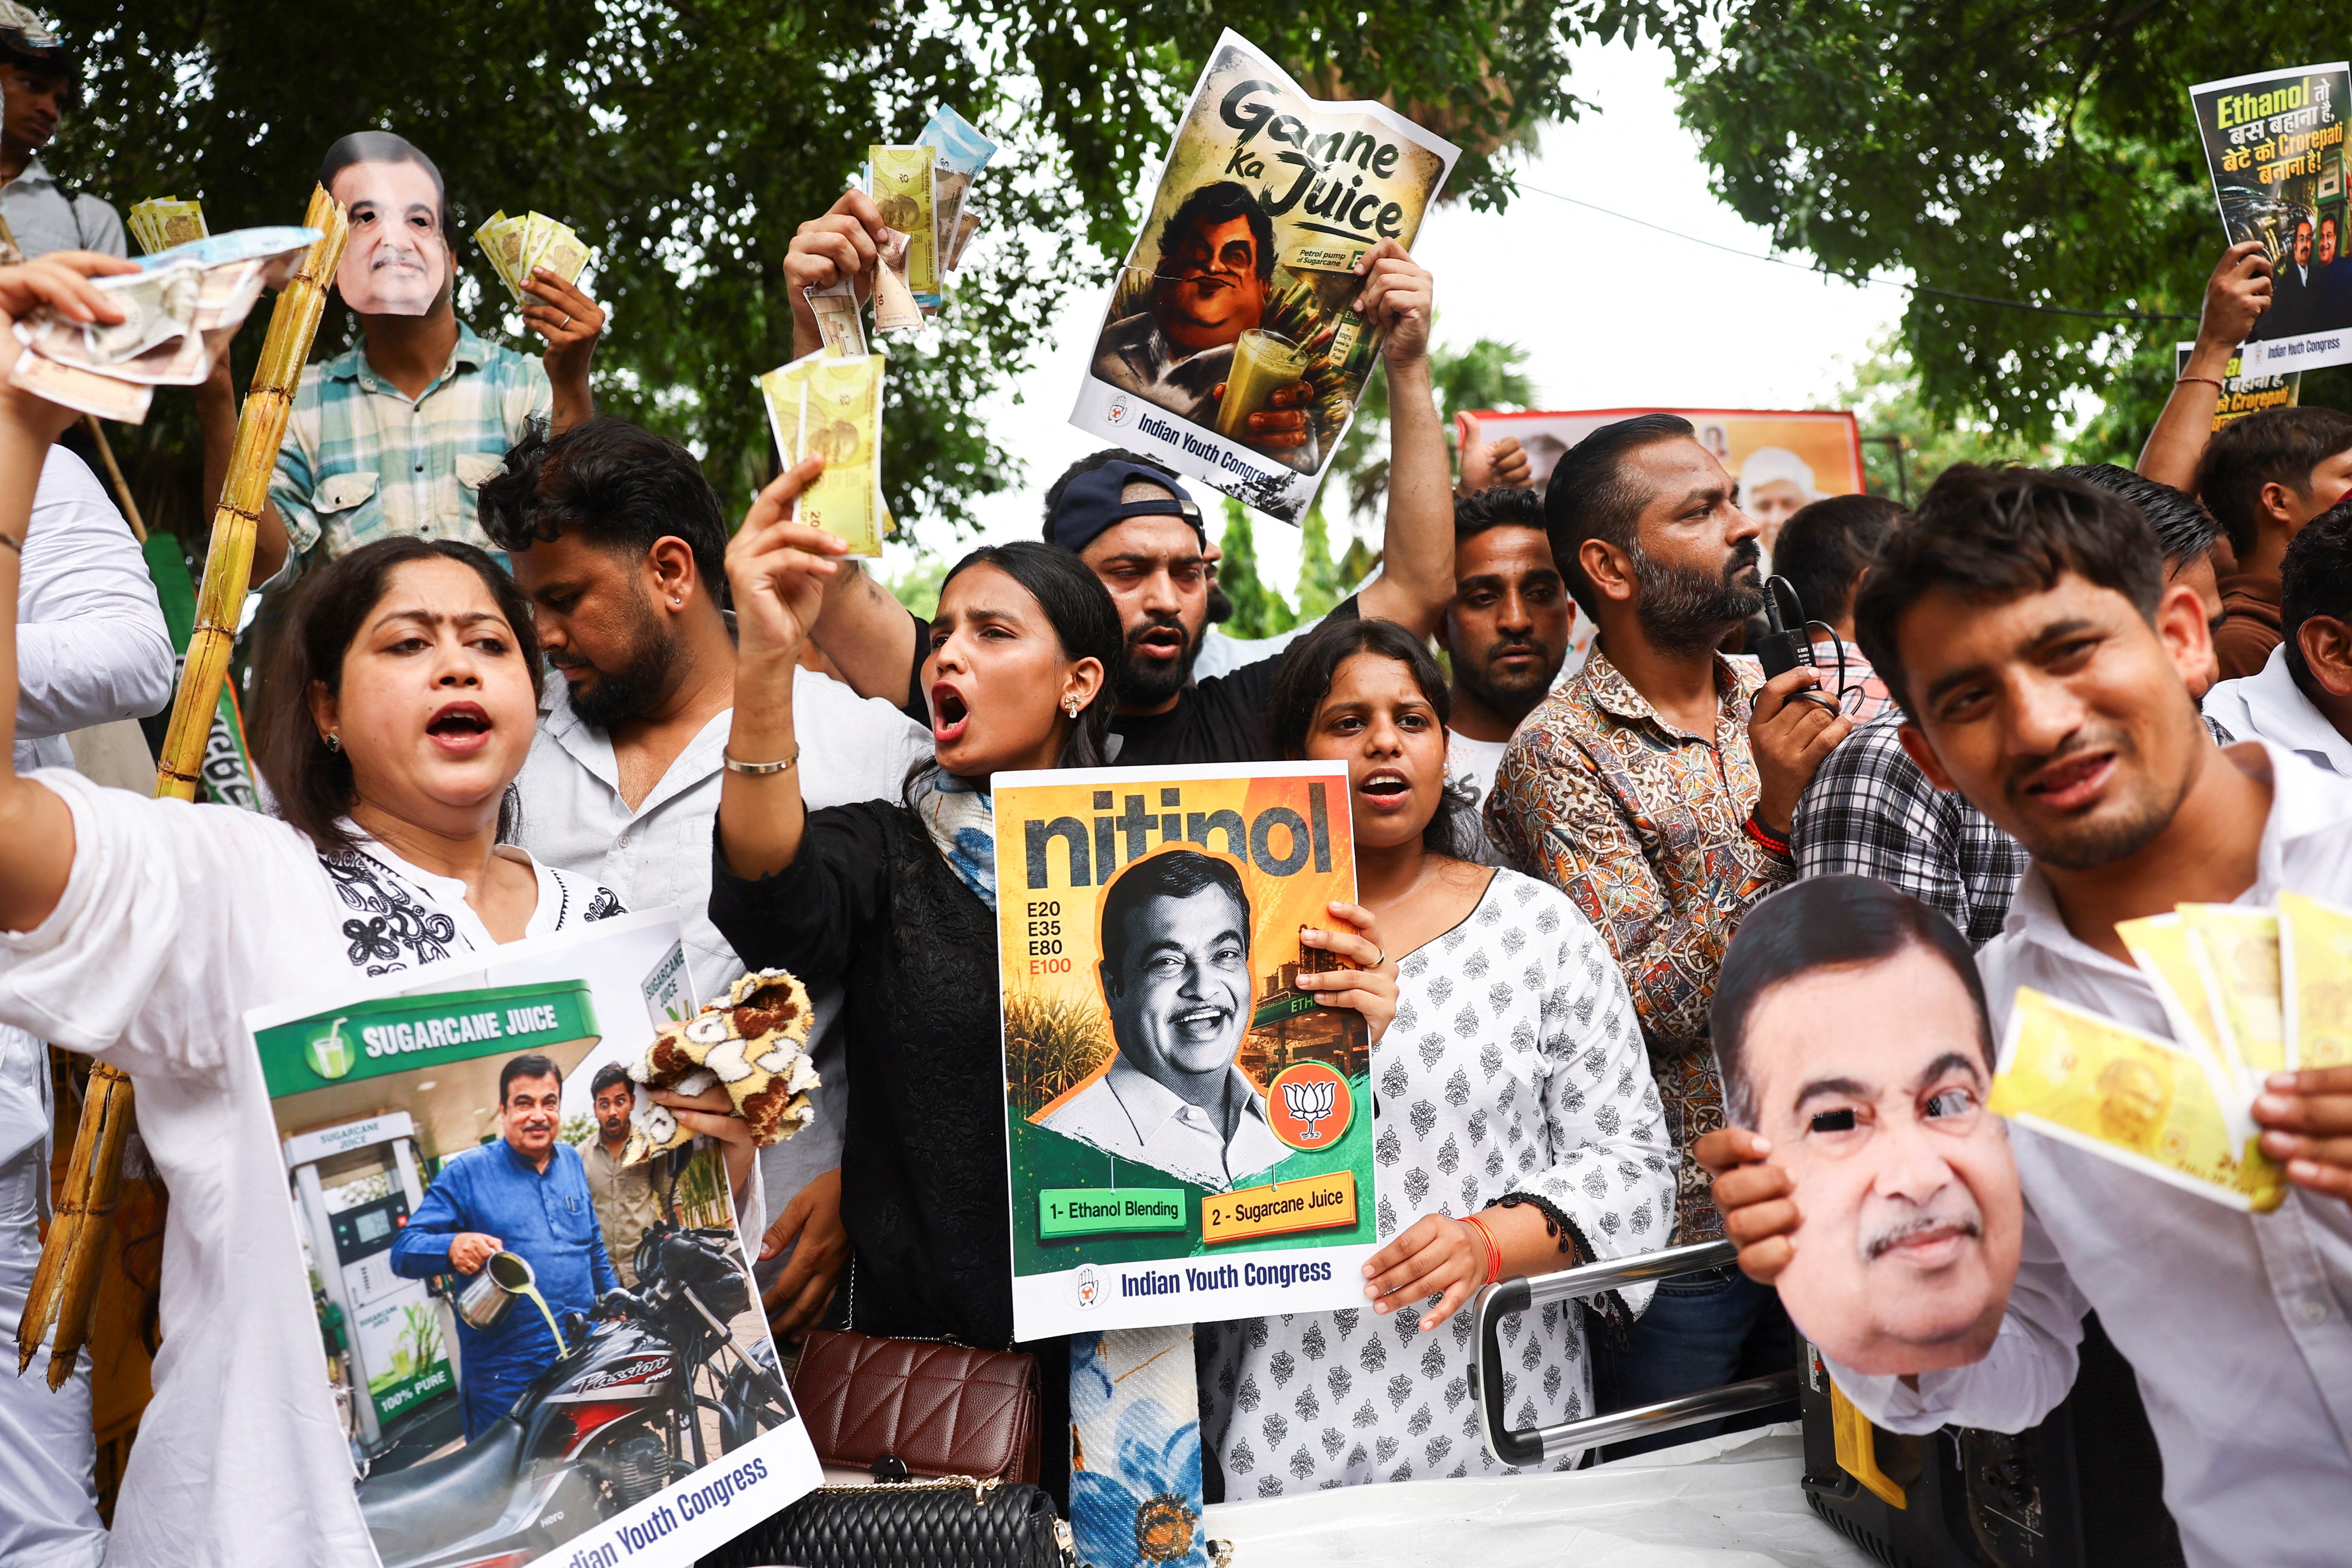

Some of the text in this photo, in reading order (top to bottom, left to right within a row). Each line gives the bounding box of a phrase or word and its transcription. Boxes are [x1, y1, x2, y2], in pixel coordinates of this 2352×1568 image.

[2217, 76, 2331, 130] Ethanol तो
[1220, 79, 1399, 179] Ganne
[2228, 119, 2265, 145] बस
[2268, 106, 2319, 134] बहाना
[2222, 120, 2343, 172] बेटे को Crorepati
[1225, 148, 1265, 179] Ka
[2257, 155, 2305, 184] बनाना
[1259, 151, 1402, 239] Juice
[1300, 249, 1323, 257] Petrol
[1303, 257, 1341, 267] Sugarcane
[878, 294, 884, 305] 10
[1339, 332, 1352, 341] 100%
[1332, 353, 1342, 361] Fuel
[1333, 346, 1346, 354] Green
[2268, 338, 2340, 360] Indian Youth Congress
[1138, 413, 1272, 482] Indian Youth Congre
[810, 511, 821, 527] 20
[1025, 783, 1333, 889] nitinol
[1028, 901, 1061, 918] E20
[1028, 921, 1061, 937] E35
[1029, 940, 1062, 956] E80
[1029, 958, 1071, 975] E100
[1291, 995, 1317, 1013] ETH
[362, 1005, 558, 1058] SUGARCANE JUICE
[321, 1122, 379, 1143] SUGARCANE
[340, 1135, 366, 1149] JUICE
[1050, 1201, 1178, 1220] 1- Ethanol Blending
[1211, 1208, 1221, 1226] 2
[1235, 1197, 1305, 1223] Sugarcane
[1308, 1189, 1344, 1208] Juice
[1121, 1261, 1332, 1297] Indian Youth Congress
[572, 1357, 669, 1397] Passion
[644, 1368, 672, 1384] PRO
[1812, 1367, 1816, 1375] DC
[380, 1370, 447, 1413] 100% PURE
[615, 1505, 678, 1555] Youth
[677, 1457, 768, 1522] Congress
